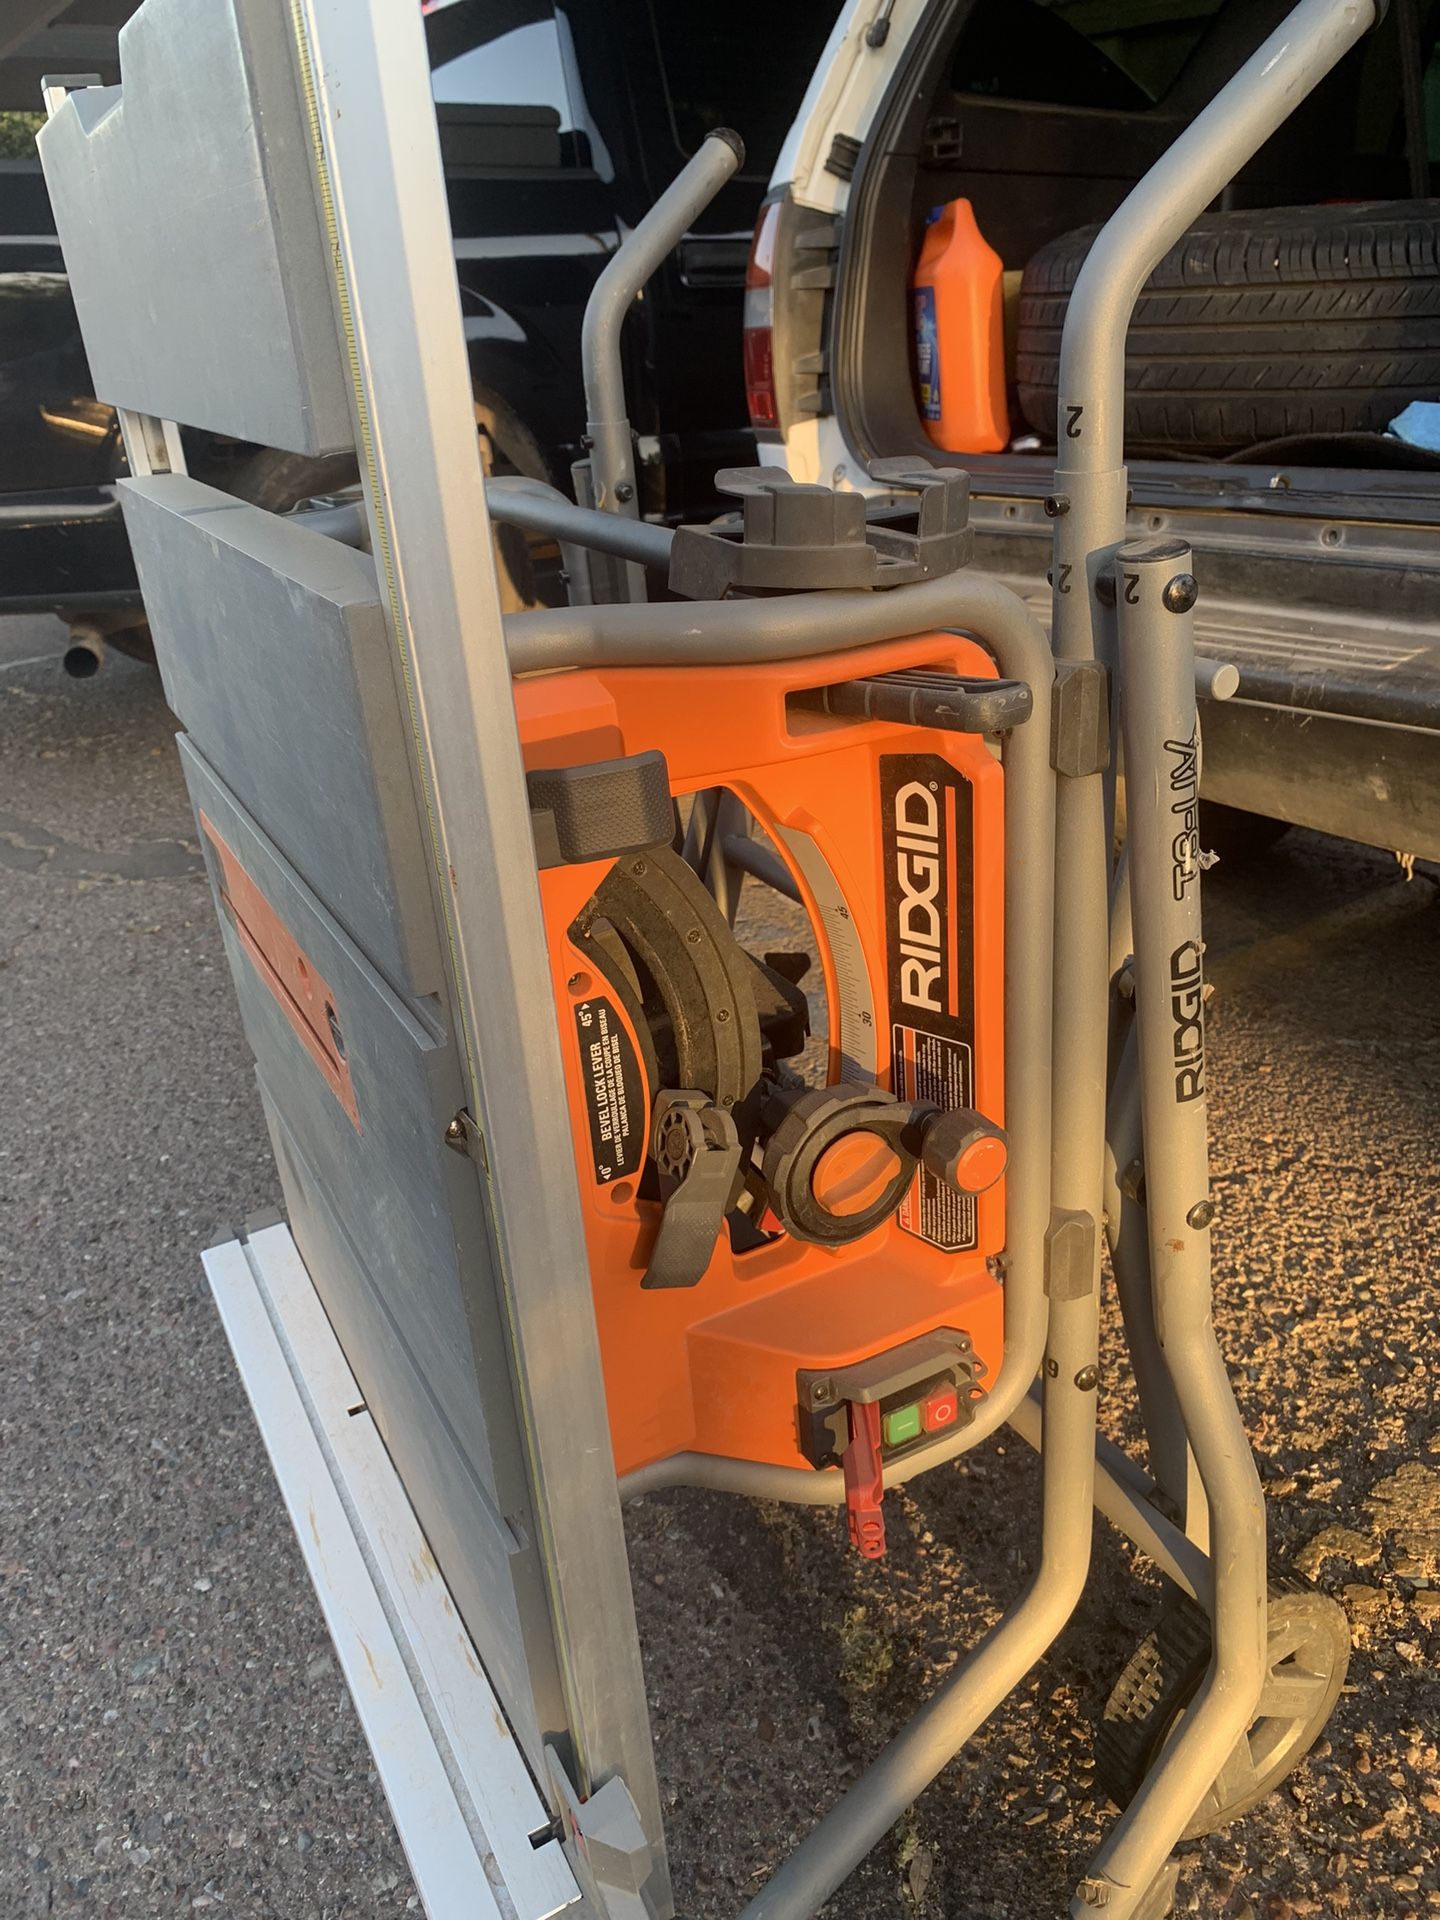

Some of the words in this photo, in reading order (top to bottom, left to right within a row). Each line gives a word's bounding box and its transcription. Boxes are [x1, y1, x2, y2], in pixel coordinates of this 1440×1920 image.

[1066, 406, 1083, 438] 2
[1058, 563, 1072, 594] 2
[1123, 574, 1140, 605] 2
[838, 905, 850, 920] 45
[598, 1008, 608, 1035] BISEAU
[862, 1011, 872, 1027] 30
[1170, 940, 1204, 1104] RIDGID
[601, 1035, 610, 1046] EN
[610, 1033, 620, 1054] BISEL
[590, 1041, 605, 1078] LEVER
[603, 1045, 612, 1067] COUPE
[613, 1054, 621, 1064] DE
[605, 1066, 613, 1078] LA
[606, 1077, 615, 1088] DE
[614, 1064, 625, 1095] BLOQUEO
[594, 1077, 608, 1107] LOCK
[618, 1095, 626, 1105] DE
[598, 1106, 613, 1142] BEVEL
[619, 1104, 630, 1137] PALANCA
[614, 1133, 622, 1143] DE
[614, 1142, 625, 1167] LEVIER
